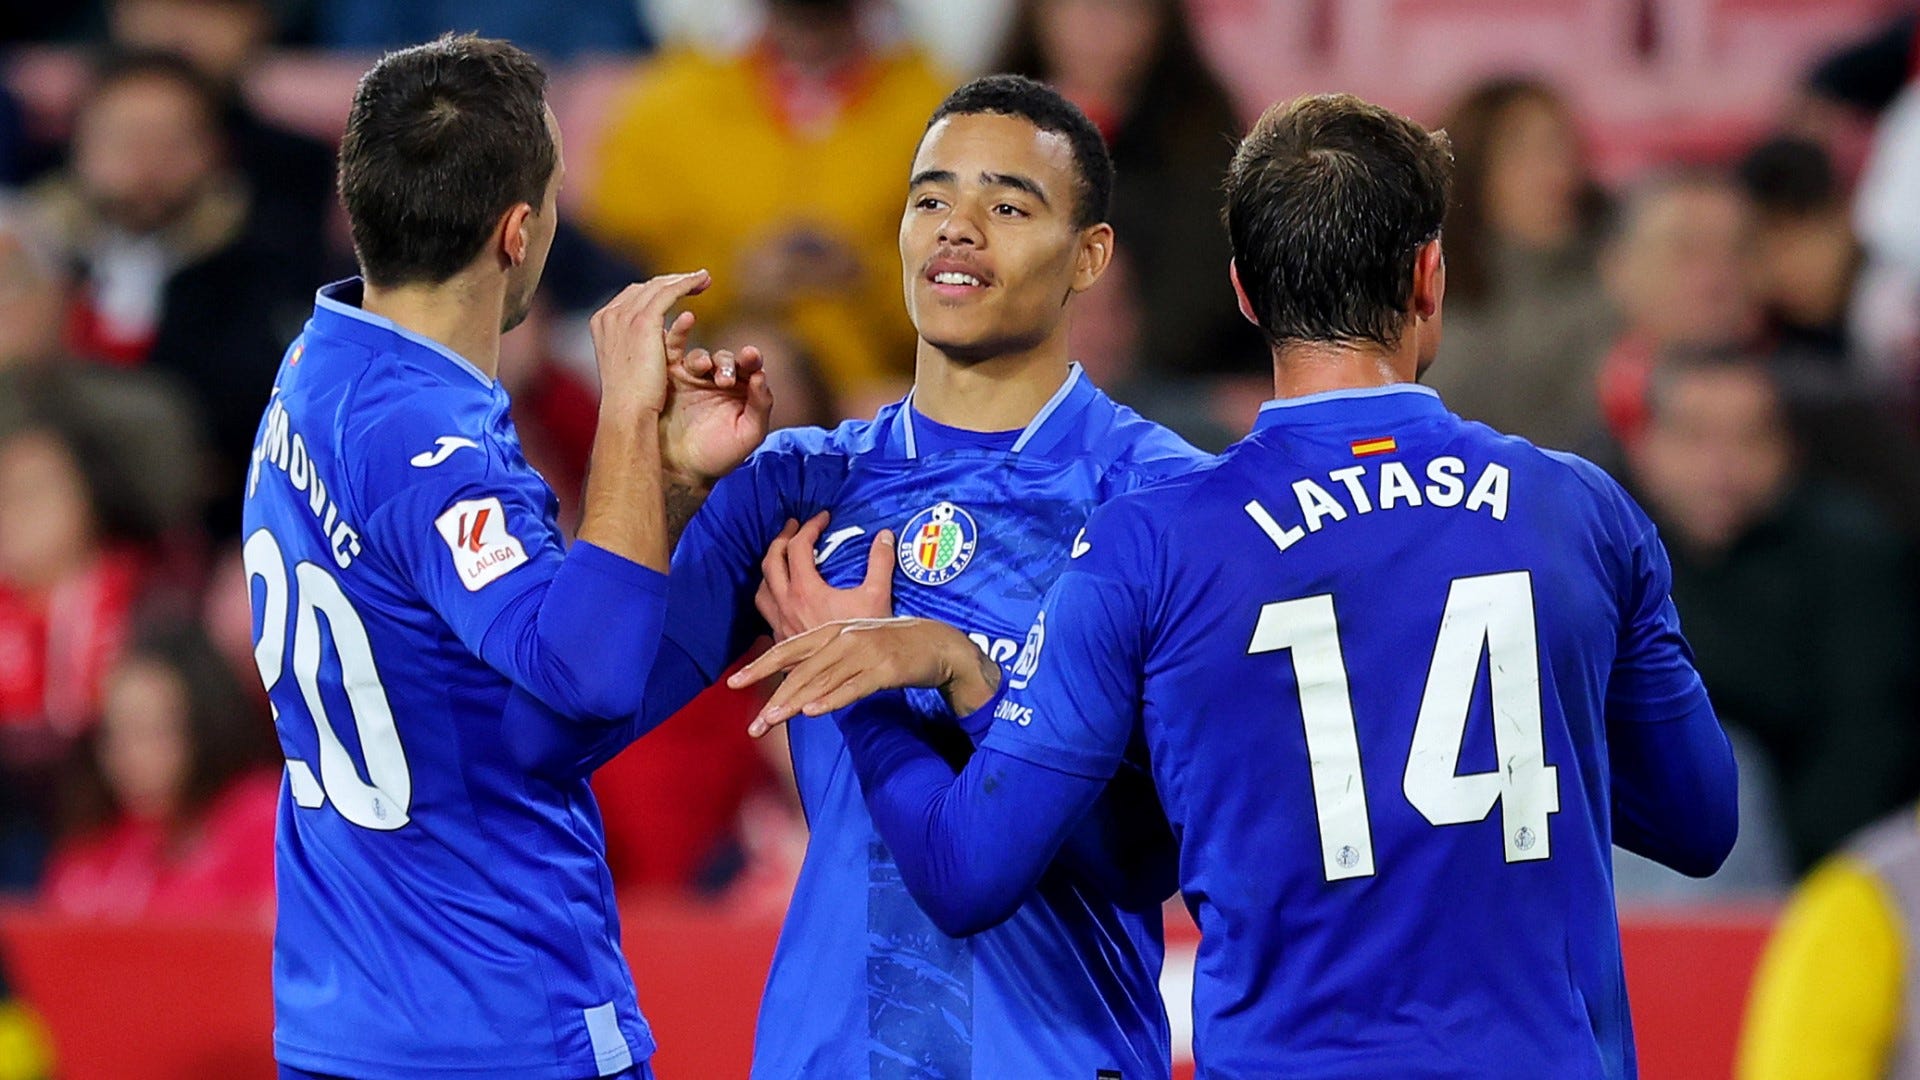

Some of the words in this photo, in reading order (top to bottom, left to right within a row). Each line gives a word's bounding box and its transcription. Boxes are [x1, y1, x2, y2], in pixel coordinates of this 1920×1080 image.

[250, 400, 361, 569] MOVIC
[1244, 456, 1510, 552] LATASA
[467, 546, 516, 578] LALIGA
[901, 542, 926, 579] GETAFE
[242, 528, 412, 831] 20
[1247, 570, 1560, 882] 14
